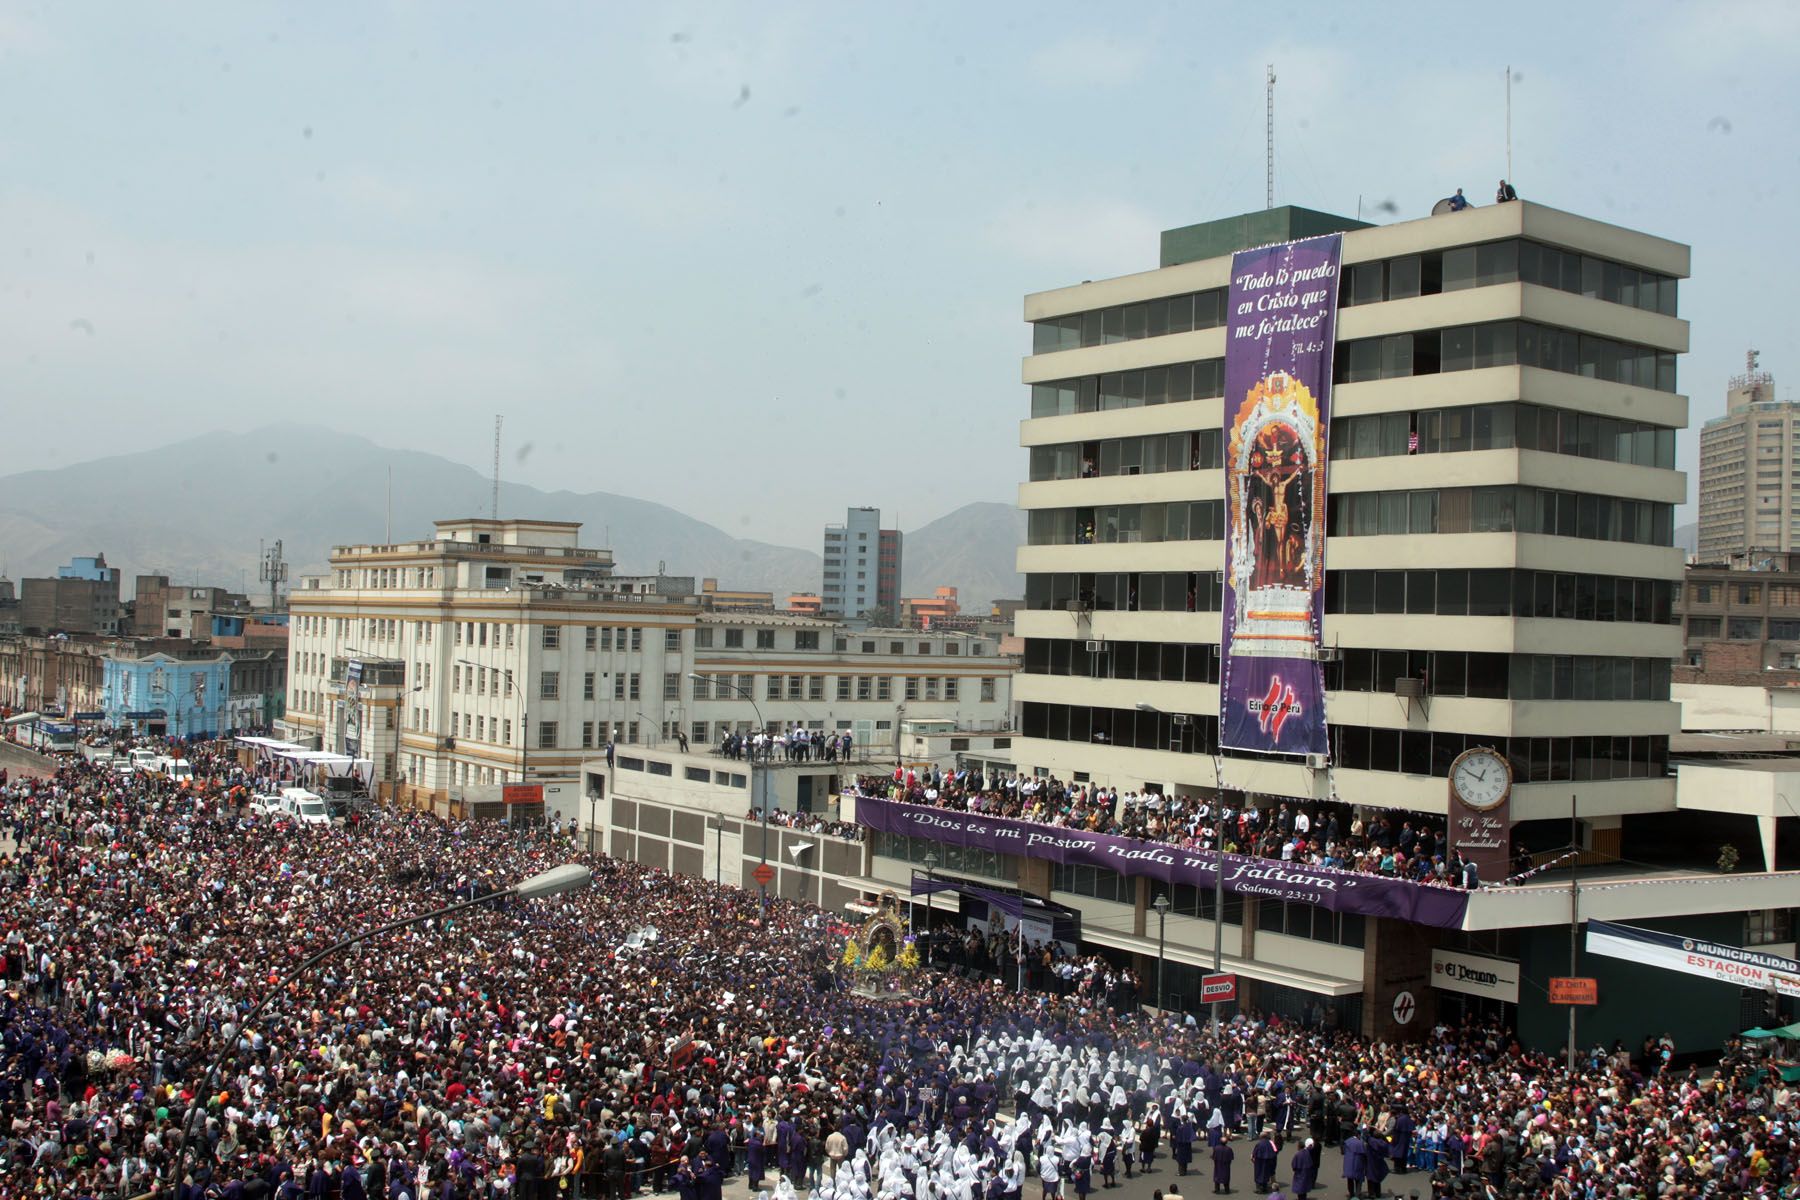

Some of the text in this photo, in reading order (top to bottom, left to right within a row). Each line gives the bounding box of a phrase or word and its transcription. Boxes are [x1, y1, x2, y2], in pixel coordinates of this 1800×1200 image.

[1275, 269, 1289, 285] lo
[1292, 261, 1336, 286] puedo
[1237, 289, 1328, 315] en Cristo que
[1235, 322, 1254, 338] me
[1249, 700, 1278, 712] Ediora
[1470, 828, 1490, 838] de la
[966, 822, 987, 835] es
[995, 826, 1021, 839] mi
[1026, 832, 1096, 852] pastor,
[1108, 844, 1175, 865] nada
[1183, 856, 1218, 872] me
[1234, 882, 1321, 904] (Salmos 23:1)
[1686, 955, 1763, 980] ESTACIÓN
[1696, 943, 1798, 971] MUNICIPALIDAD
[1445, 962, 1456, 976] El
[1457, 964, 1498, 985] Peruano
[1716, 971, 1727, 980] Dr.
[1729, 973, 1746, 983] Luis
[1206, 984, 1231, 993] DESVIO
